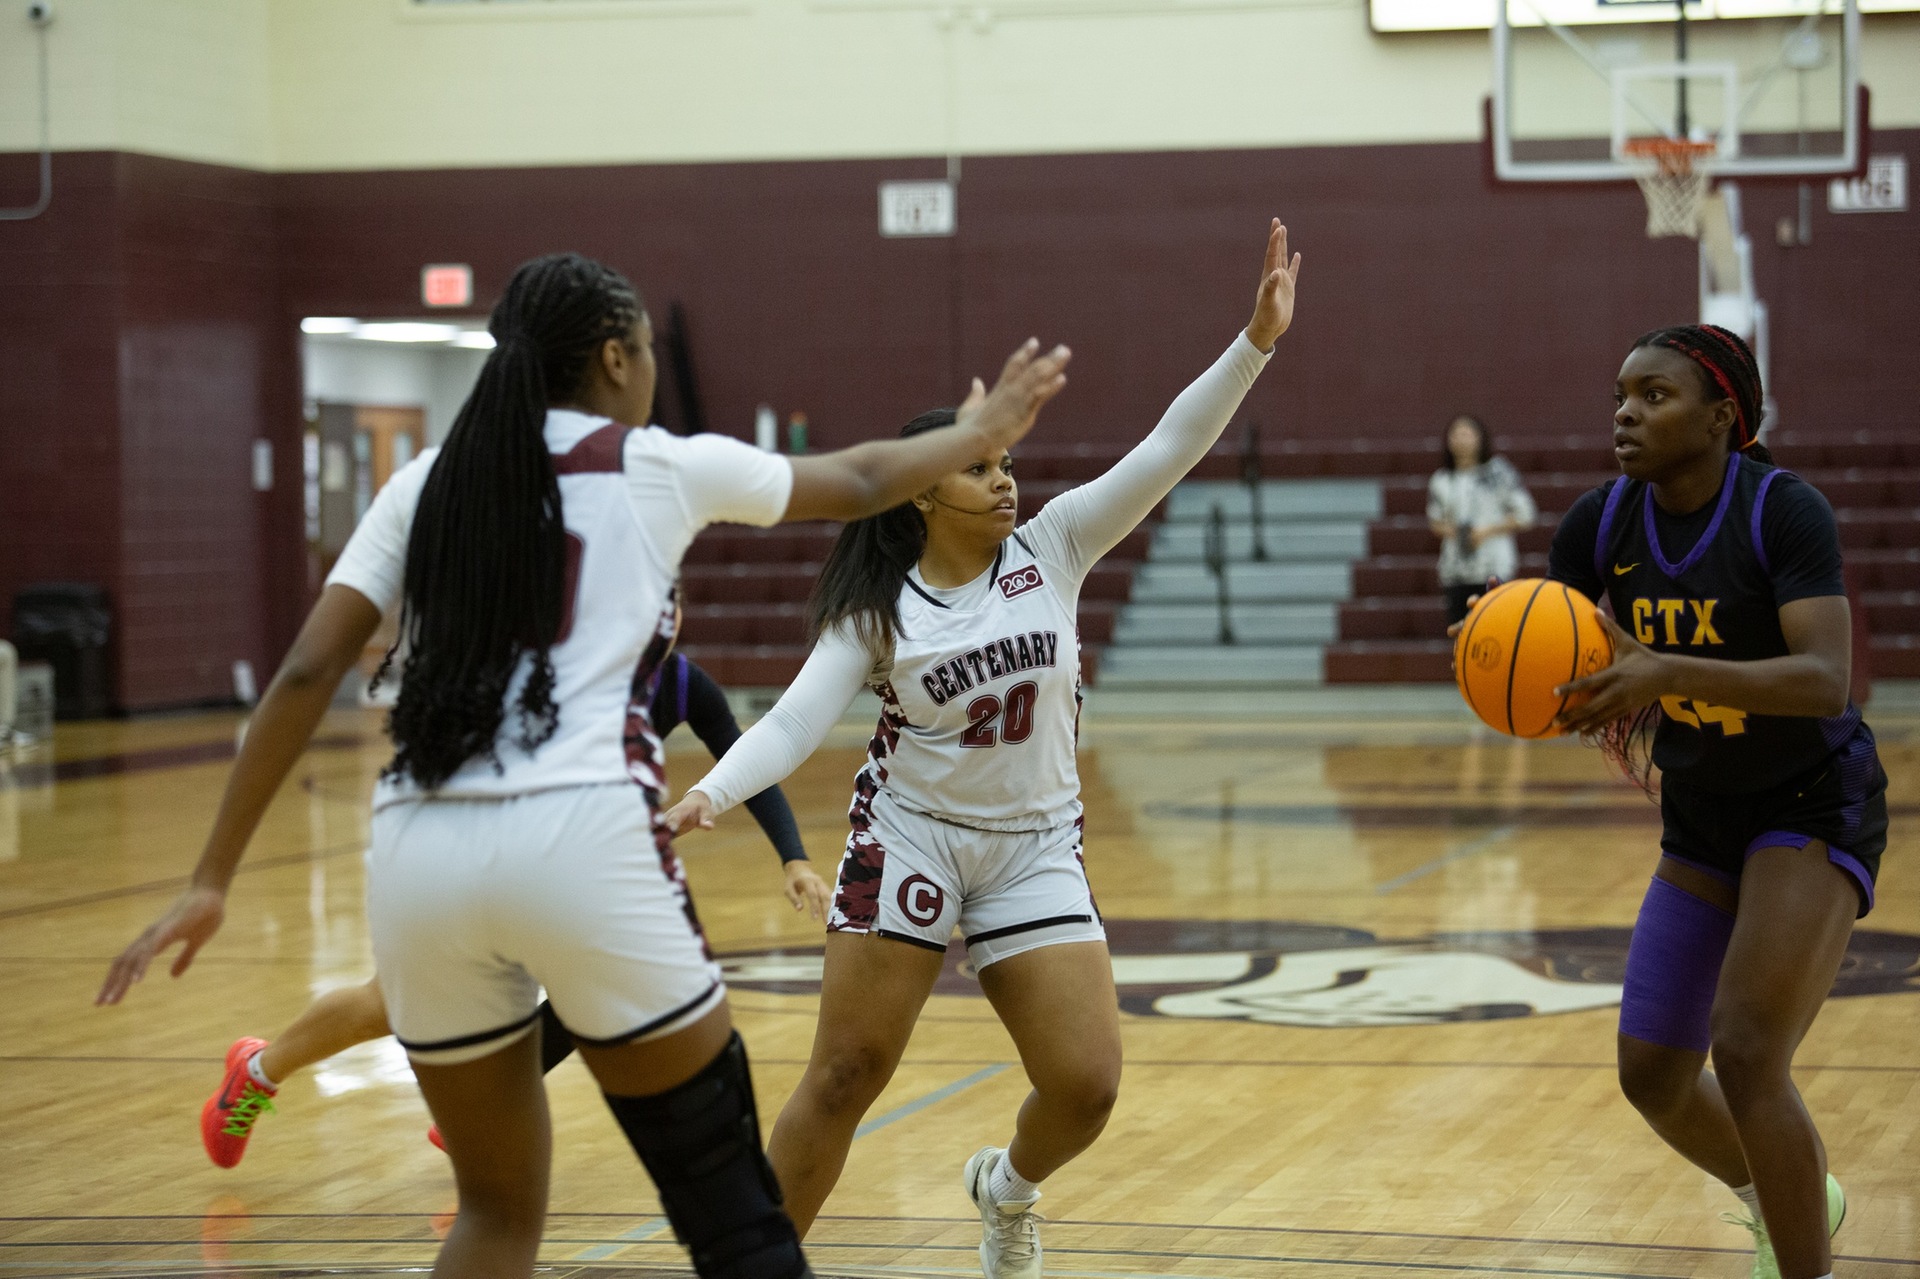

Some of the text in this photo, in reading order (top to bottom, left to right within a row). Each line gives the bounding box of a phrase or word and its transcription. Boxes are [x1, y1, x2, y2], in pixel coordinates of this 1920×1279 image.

[1002, 570, 1038, 595] 200
[1632, 598, 1724, 645] CTX
[921, 631, 1057, 706] CENTENARY
[959, 681, 1038, 748] 20
[906, 881, 938, 921] C
